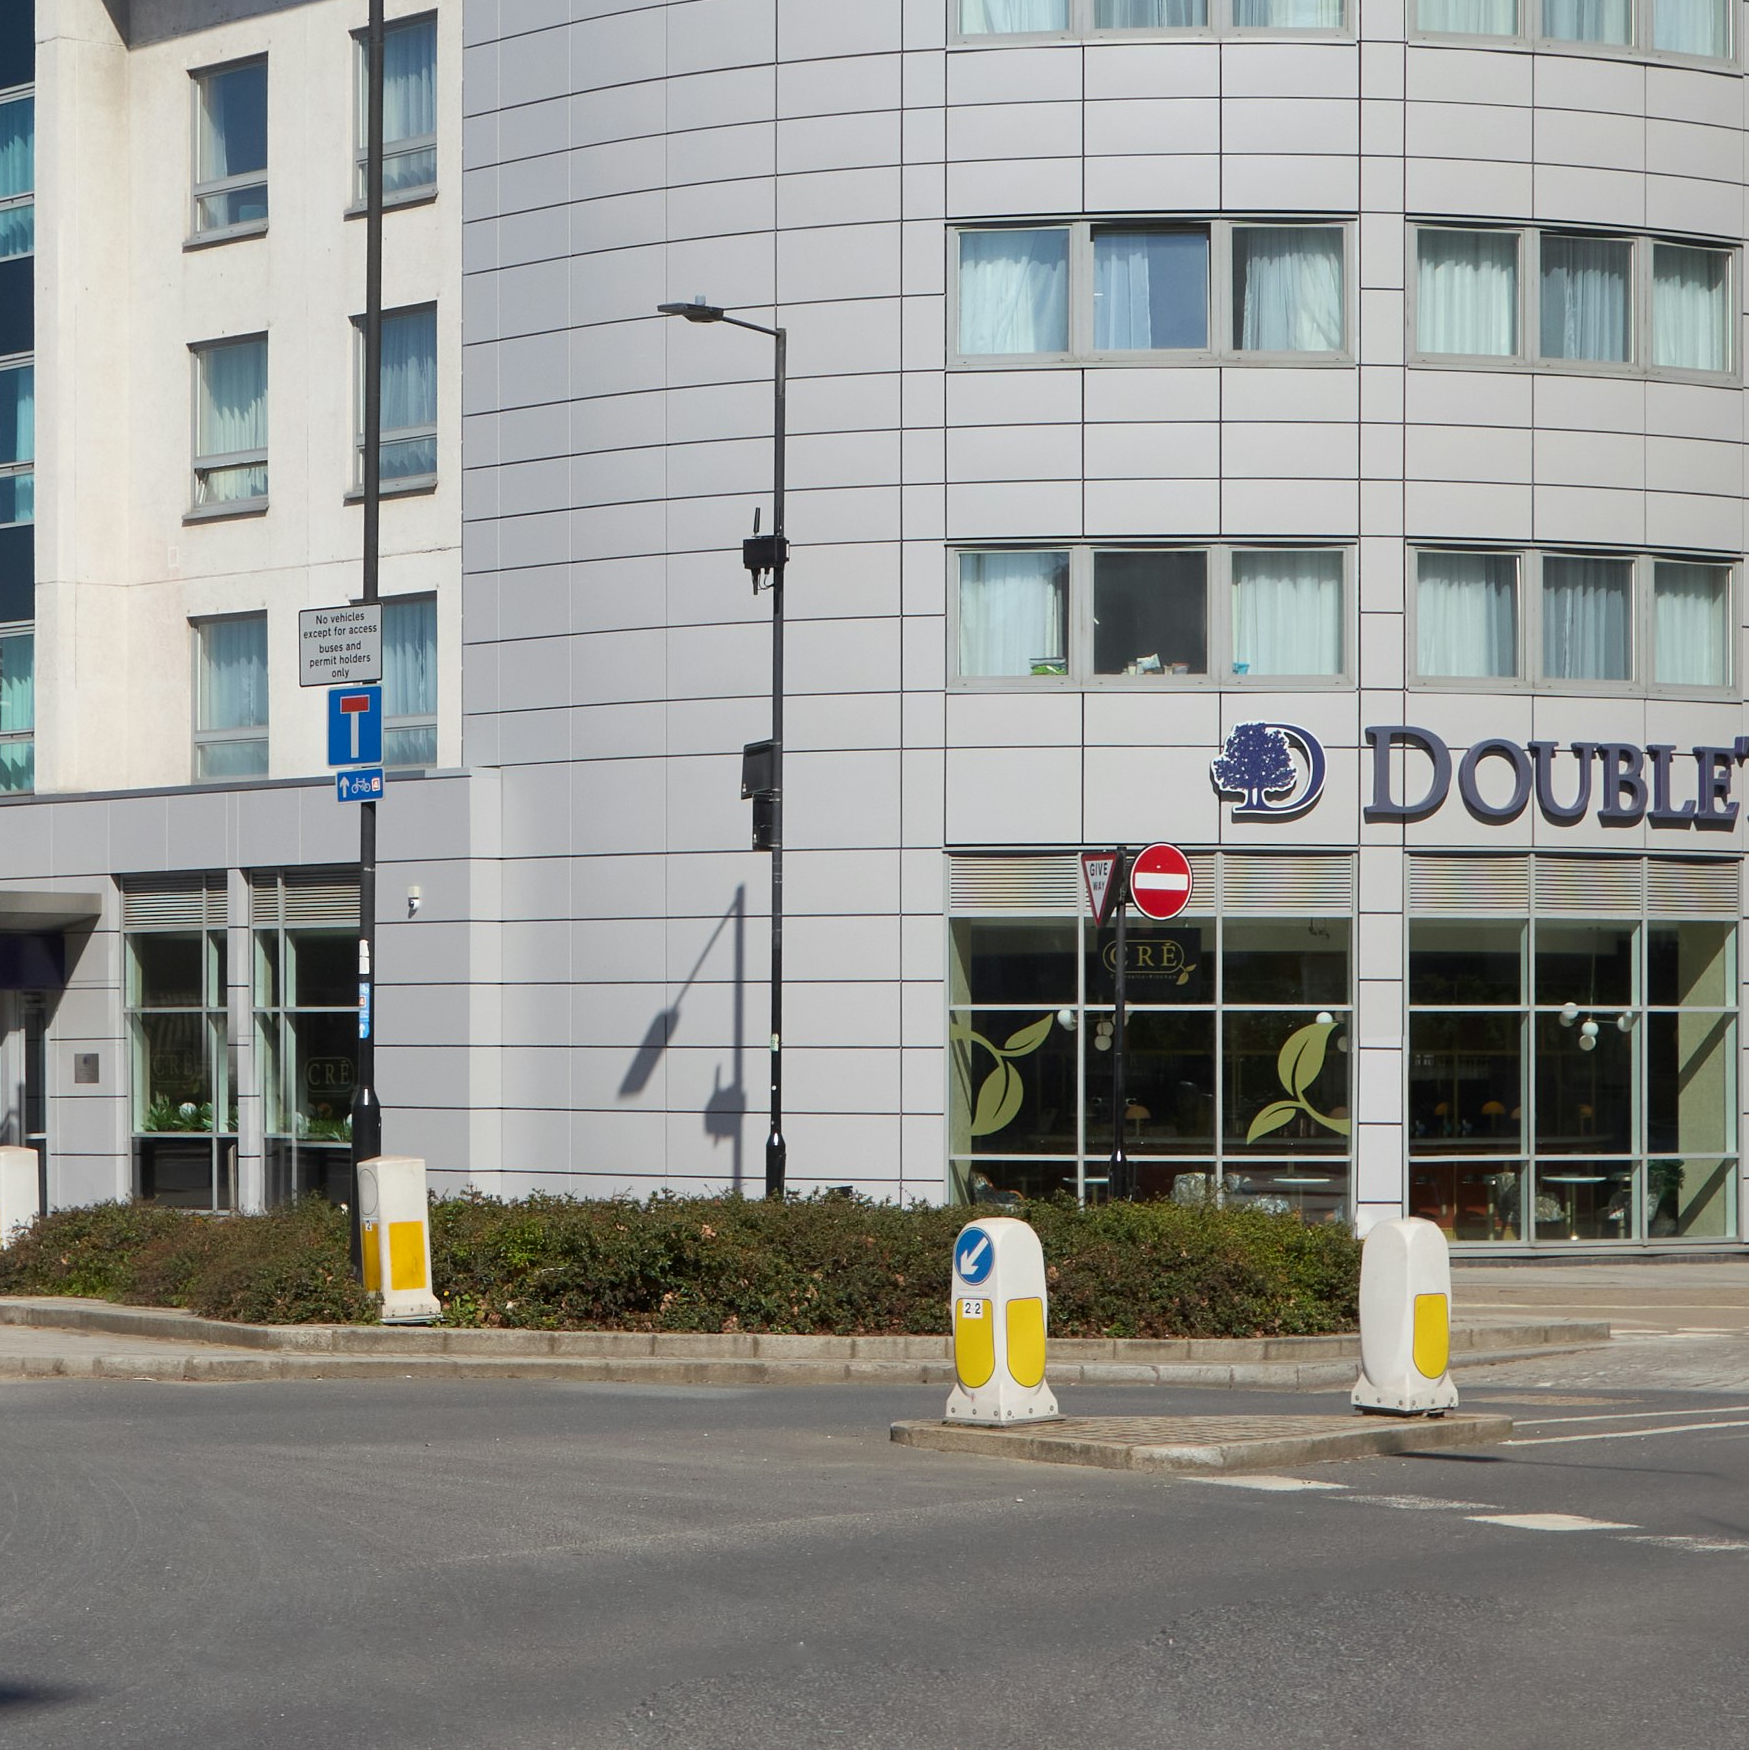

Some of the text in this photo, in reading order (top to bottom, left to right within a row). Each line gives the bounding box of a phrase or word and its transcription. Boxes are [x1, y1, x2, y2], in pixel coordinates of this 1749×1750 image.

[315, 612, 365, 625] No vehicles
[303, 624, 377, 639] except for access
[319, 640, 361, 653] buses and
[309, 654, 371, 668] permit holders
[331, 668, 349, 678] only
[1089, 862, 1108, 877] GIVE
[1093, 880, 1106, 891] WAY
